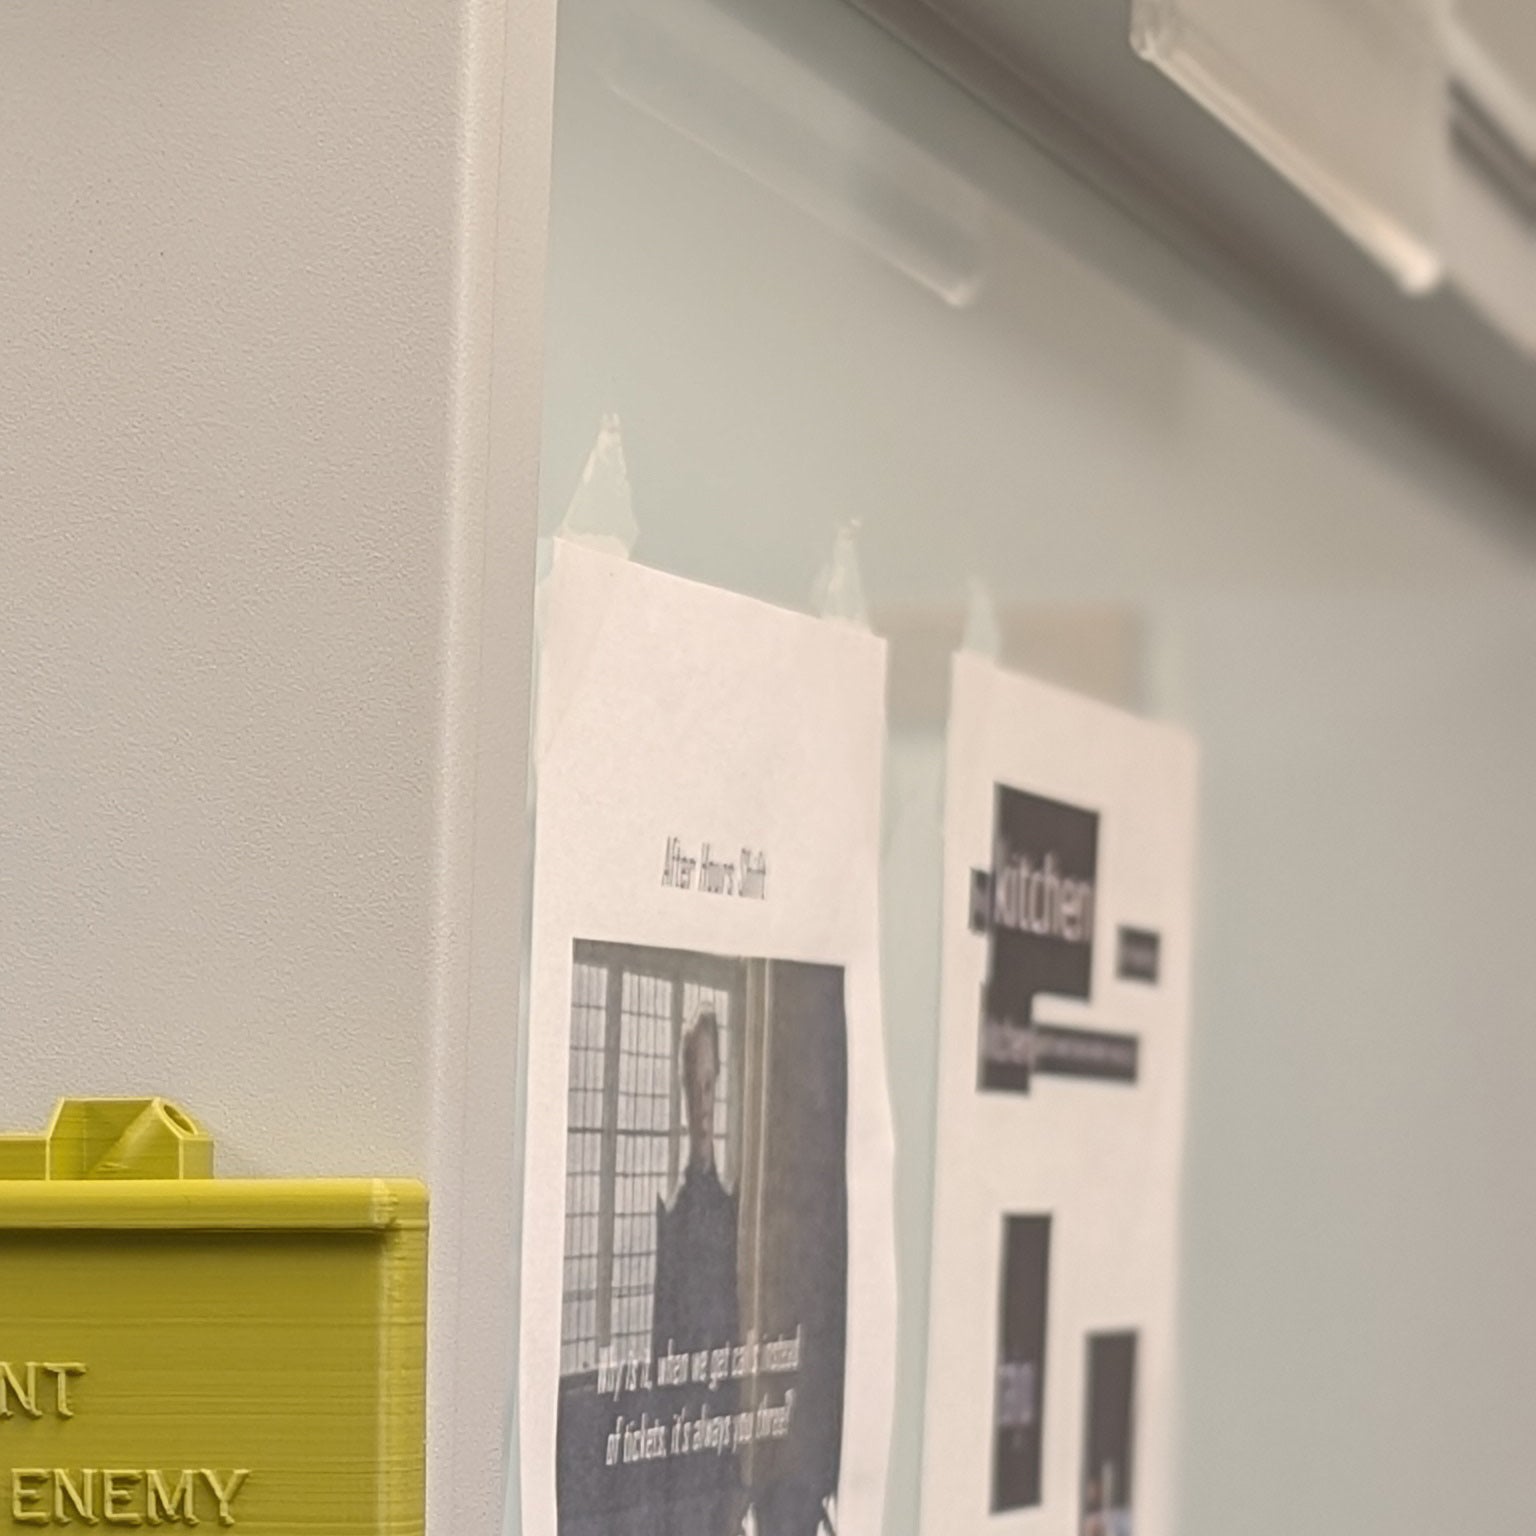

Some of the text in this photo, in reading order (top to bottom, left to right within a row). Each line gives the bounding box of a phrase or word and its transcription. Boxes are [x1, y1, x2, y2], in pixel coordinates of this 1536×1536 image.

[661, 836, 767, 901] After Hours Shift
[597, 1346, 625, 1402] Why
[625, 1349, 638, 1392] is
[657, 1338, 689, 1386] when
[691, 1350, 709, 1382] we
[709, 1340, 731, 1391] get
[761, 1323, 802, 1374] instead
[605, 1414, 625, 1466] of
[670, 1405, 691, 1455] it's
[692, 1402, 732, 1457] always
[732, 1411, 754, 1455] you
[10, 1467, 252, 1527] ENEMY
